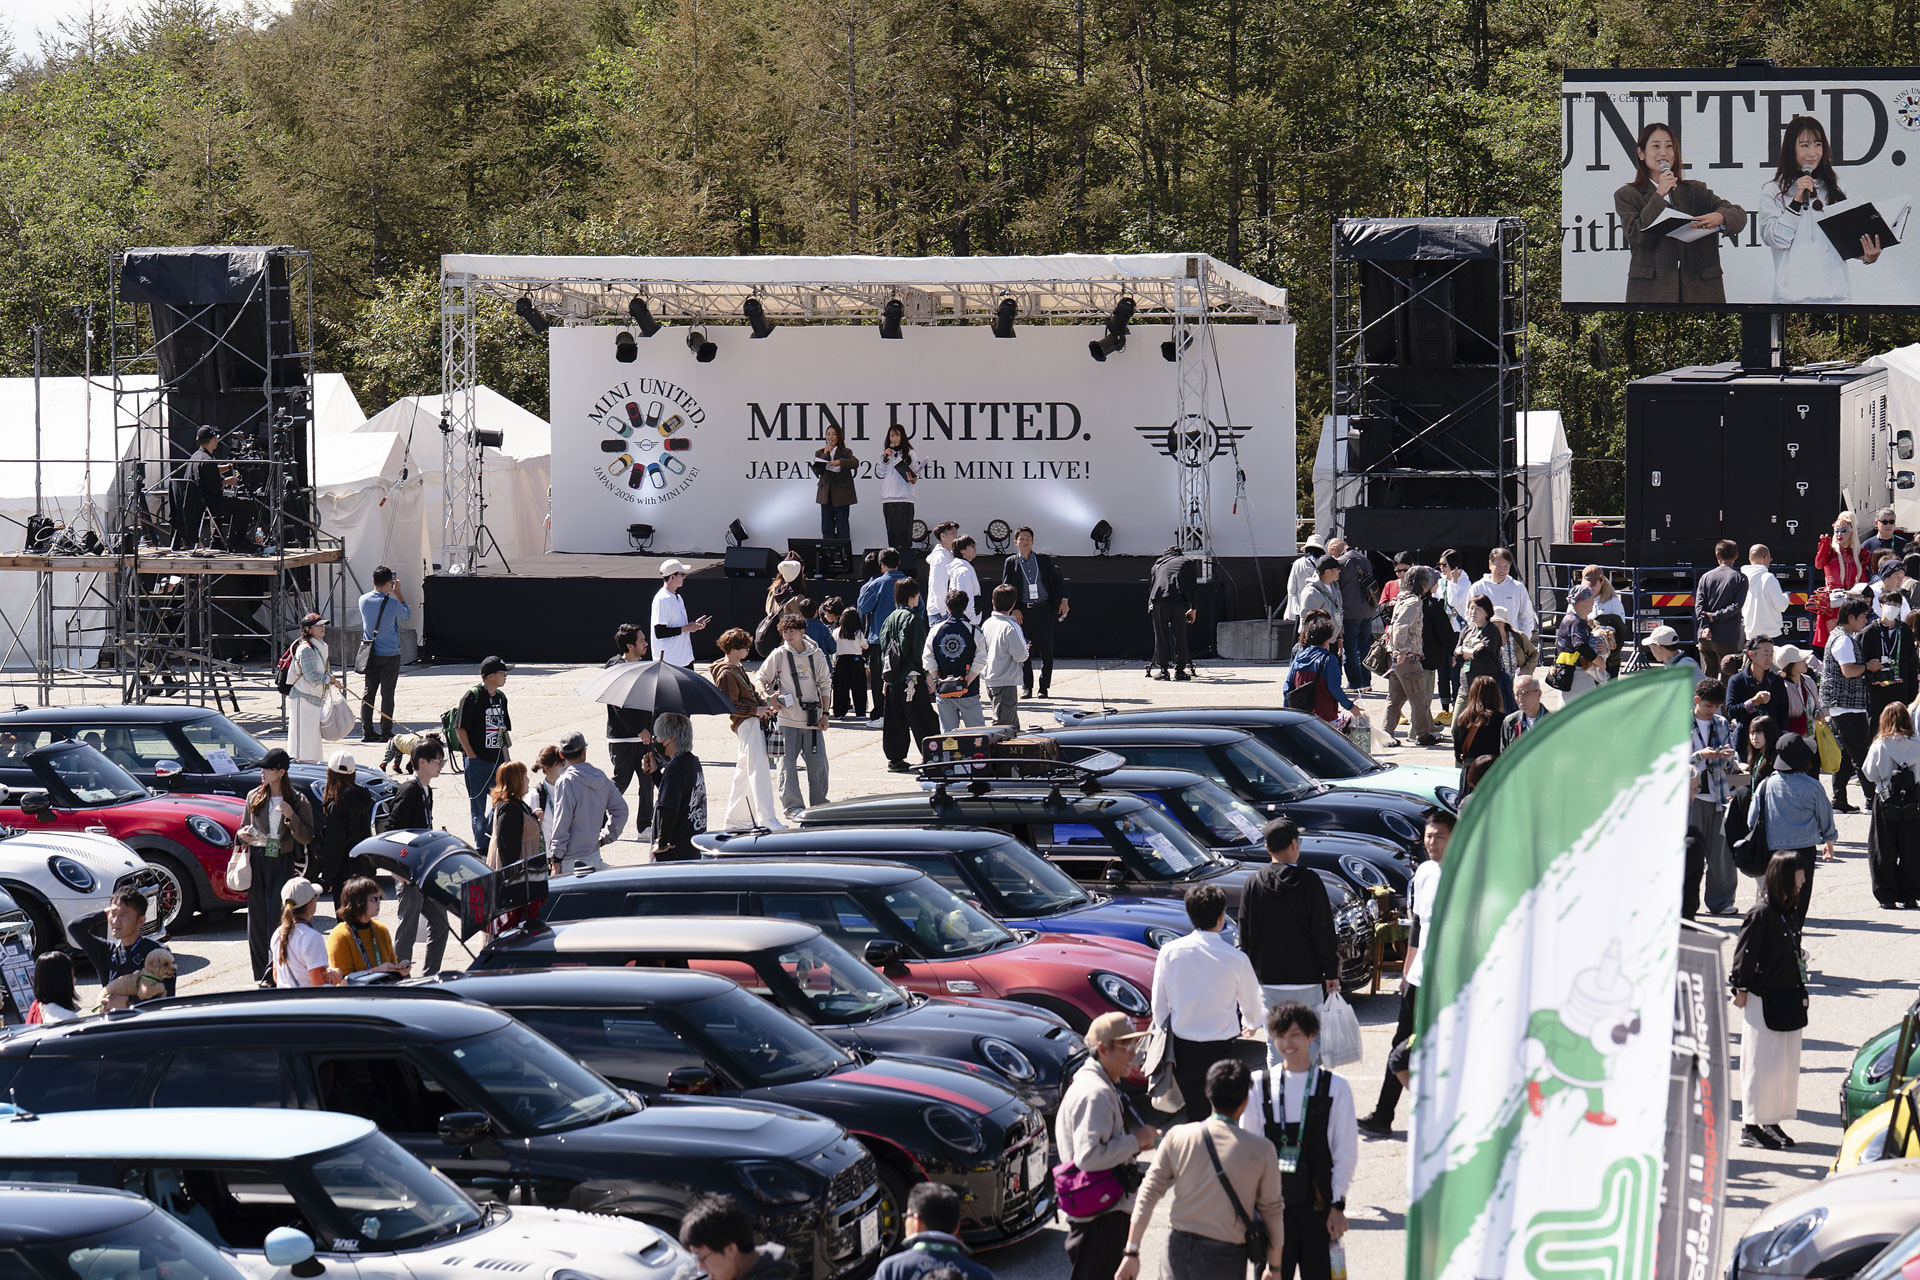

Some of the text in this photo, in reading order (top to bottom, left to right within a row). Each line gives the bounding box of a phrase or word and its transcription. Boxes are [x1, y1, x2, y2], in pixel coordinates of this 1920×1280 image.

[1562, 88, 1907, 171] NITED.
[1562, 212, 1631, 253] ith
[588, 377, 706, 429] MINI UNITED.
[746, 402, 1092, 441] MINI UNITED.
[593, 466, 701, 505] JAPAN 2026 with MINI LIVE!
[954, 461, 1014, 480] MINI
[1022, 461, 1090, 480] LIVE!
[469, 885, 484, 923] GP
